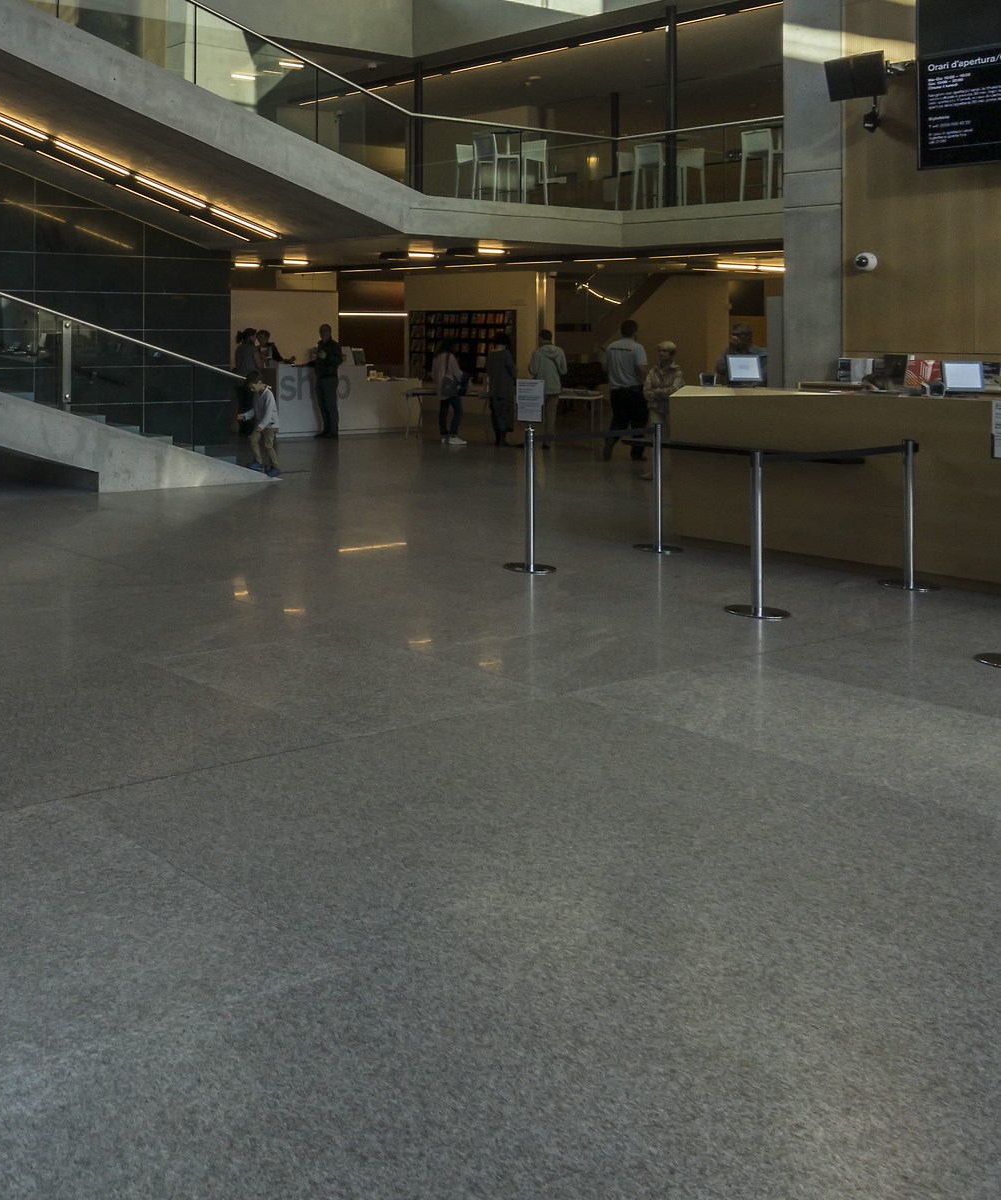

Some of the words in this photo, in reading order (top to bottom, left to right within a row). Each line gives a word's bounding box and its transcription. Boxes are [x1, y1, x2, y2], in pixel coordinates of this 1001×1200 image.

[927, 61, 950, 72] Orari
[950, 54, 1001, 68] d'apertura/
[279, 367, 352, 402] shp
